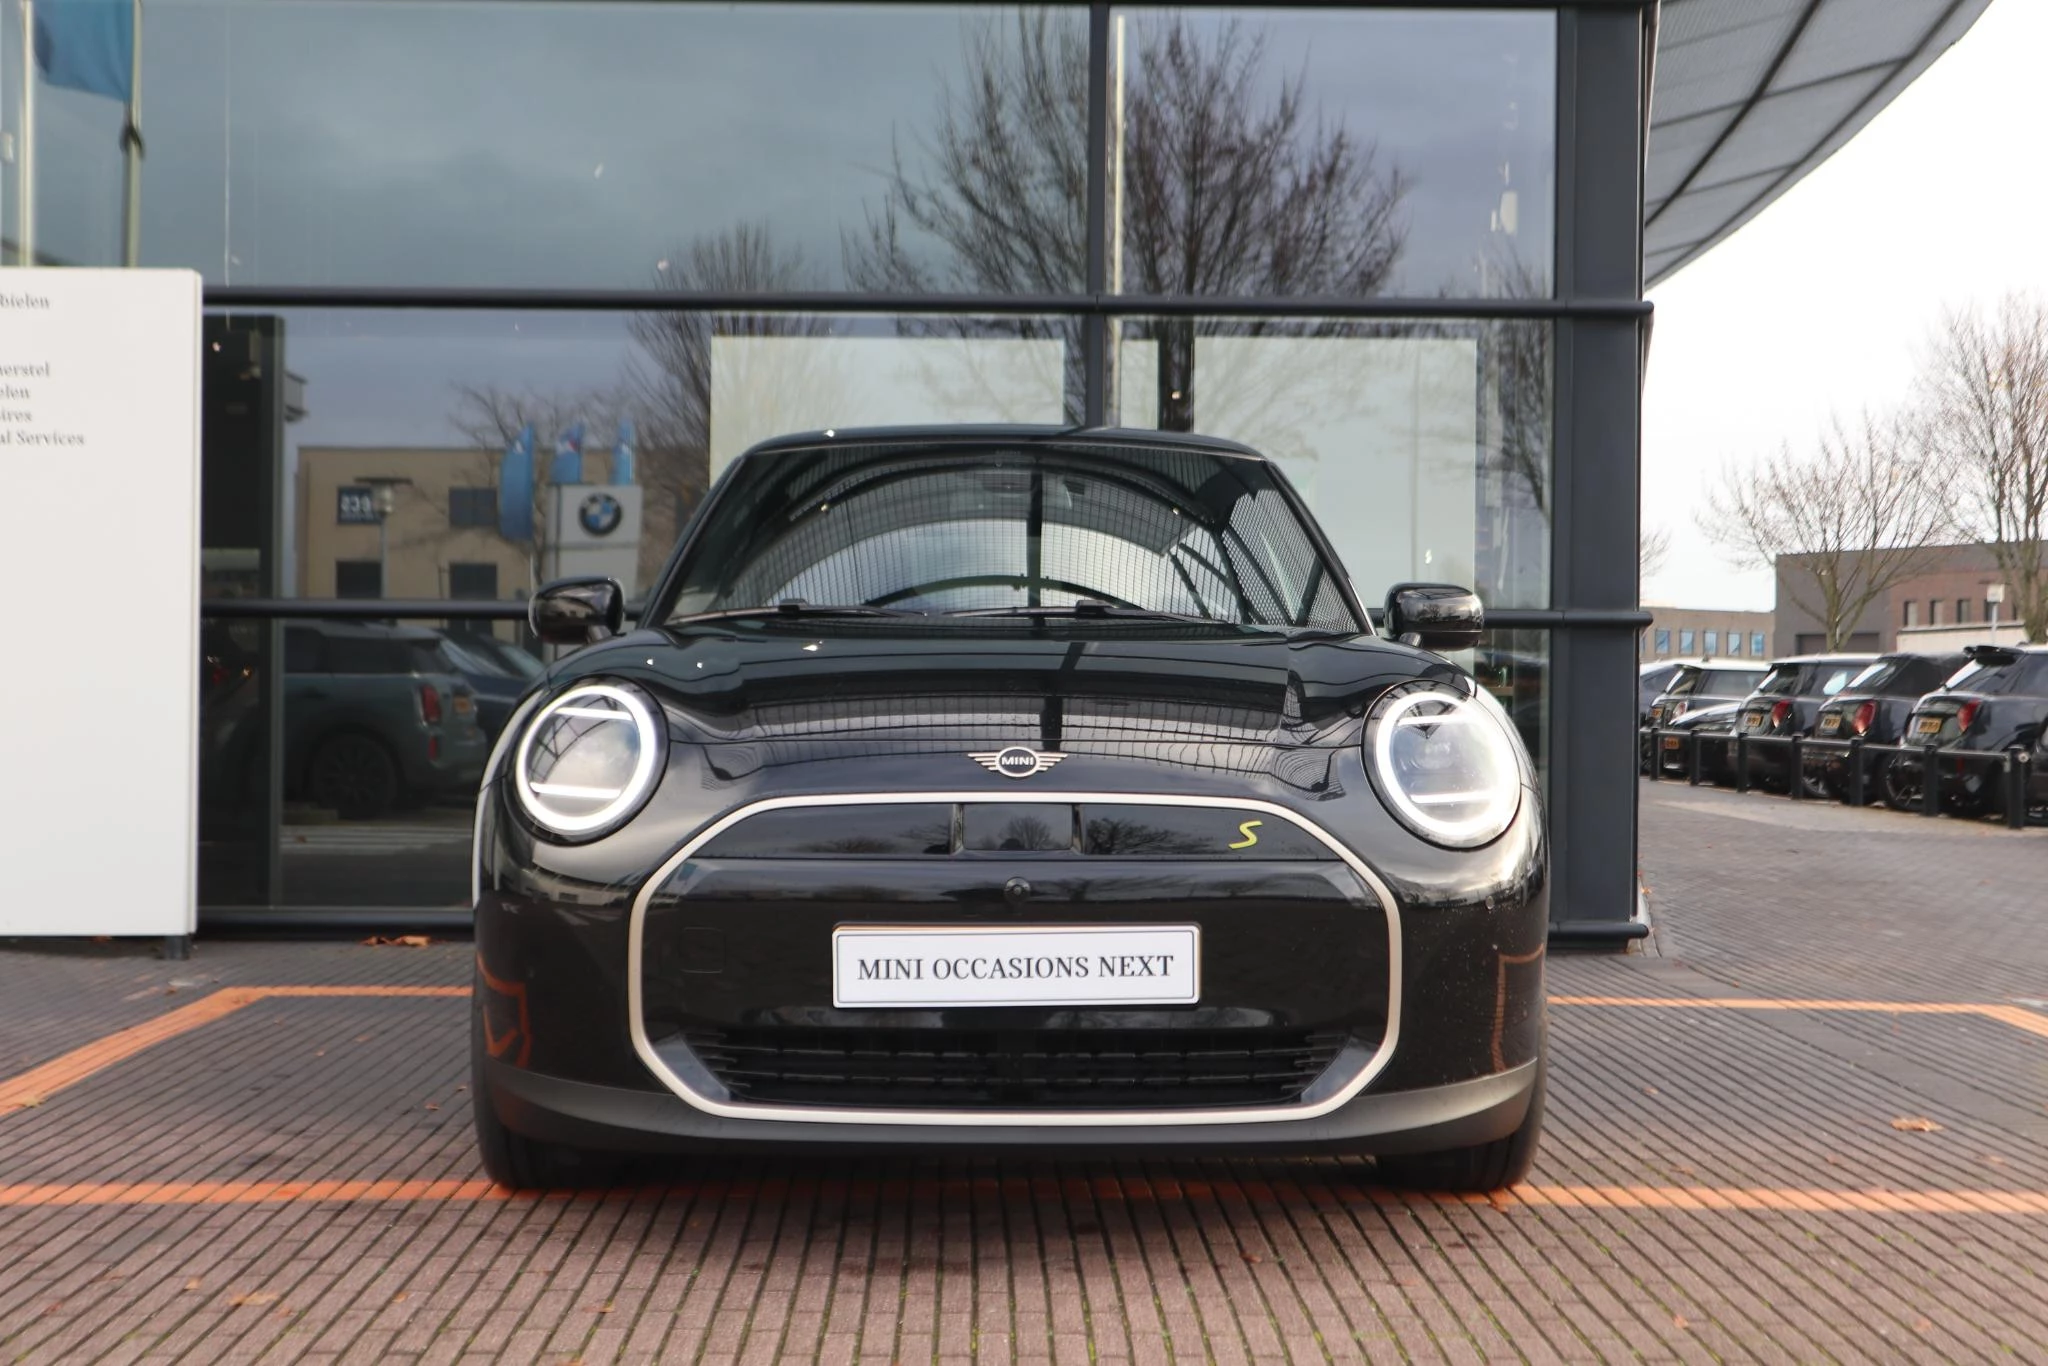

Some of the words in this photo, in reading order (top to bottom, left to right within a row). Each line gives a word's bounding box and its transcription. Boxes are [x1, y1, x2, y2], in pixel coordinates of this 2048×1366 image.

[16, 430, 85, 446] Services
[1001, 756, 1035, 766] MINI
[1229, 820, 1263, 850] S
[857, 958, 924, 981] MINI
[932, 956, 1089, 979] OCCASIONS
[1098, 955, 1174, 977] NEXT
